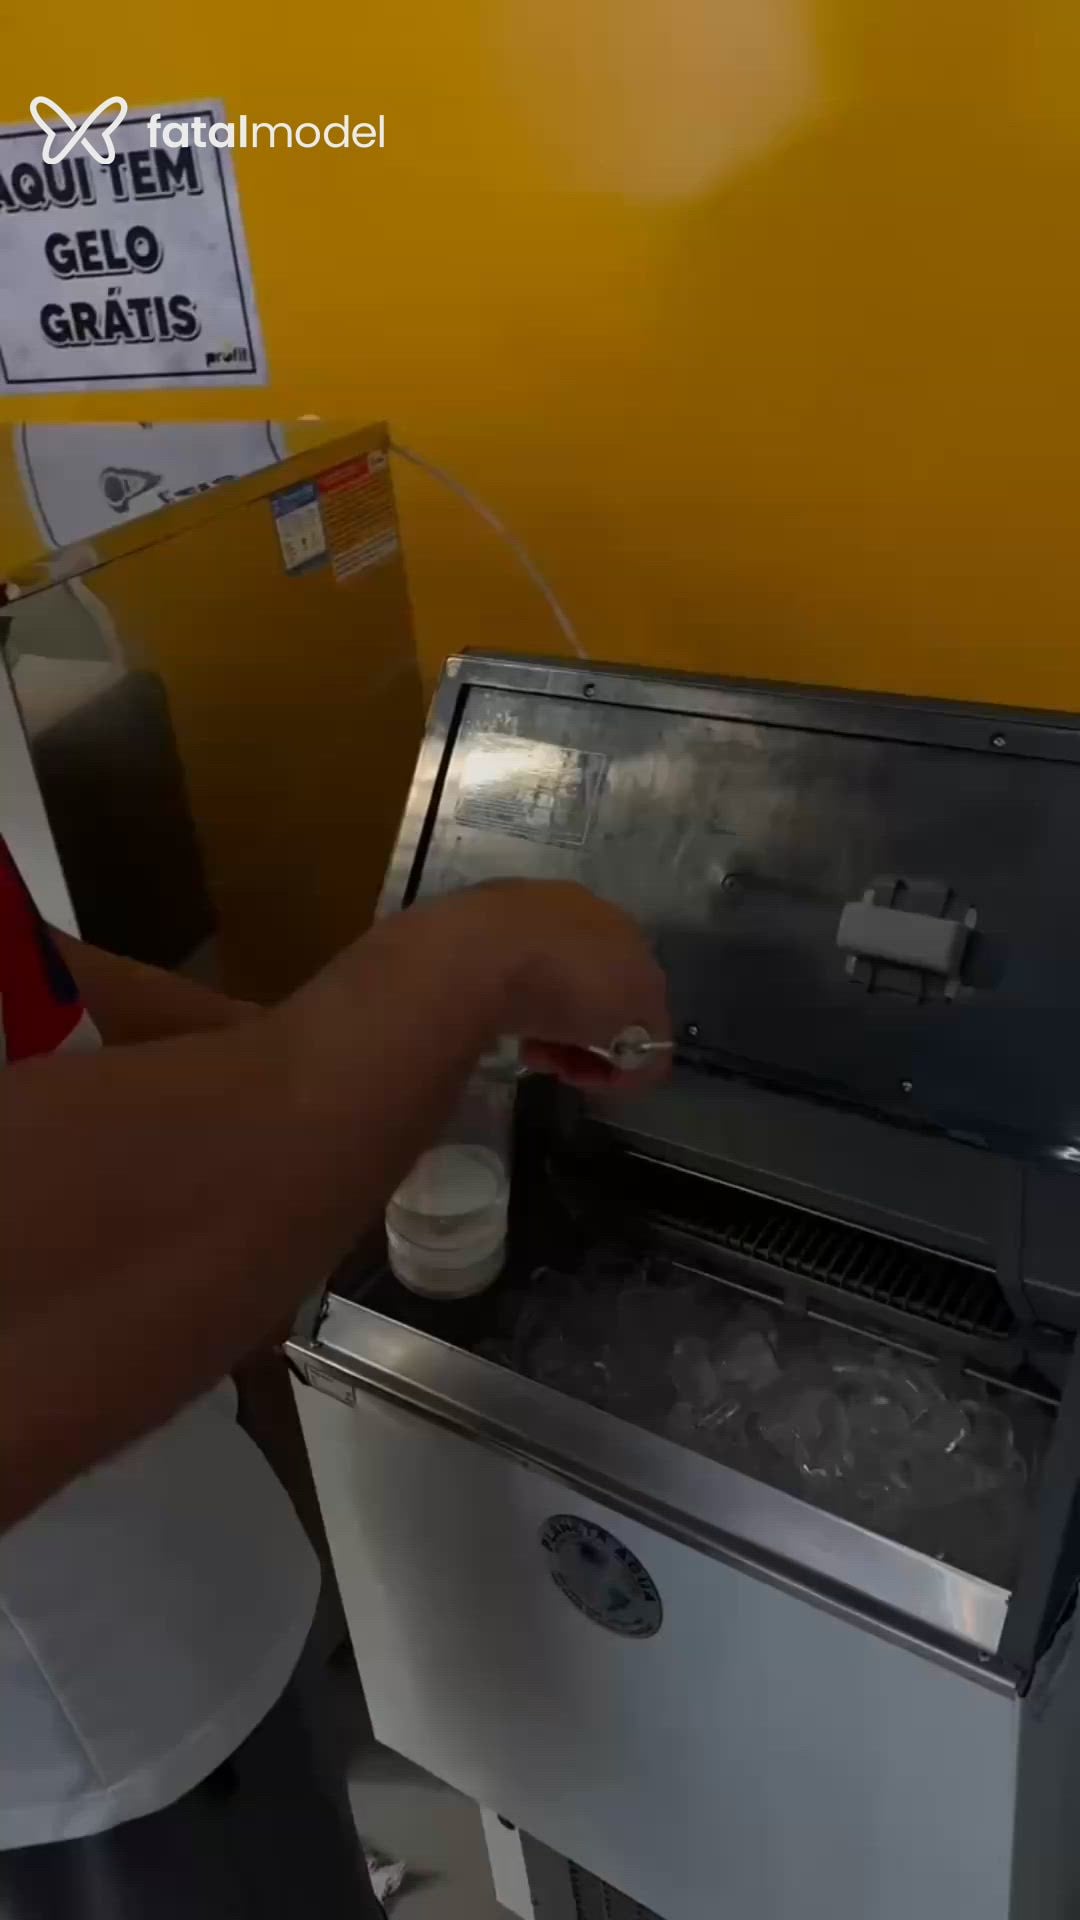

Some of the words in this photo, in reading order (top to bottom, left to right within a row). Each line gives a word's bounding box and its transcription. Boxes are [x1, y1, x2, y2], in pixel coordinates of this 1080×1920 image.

[101, 147, 203, 200] TEM
[45, 225, 162, 278] GELO
[40, 286, 201, 347] GRÁTIS
